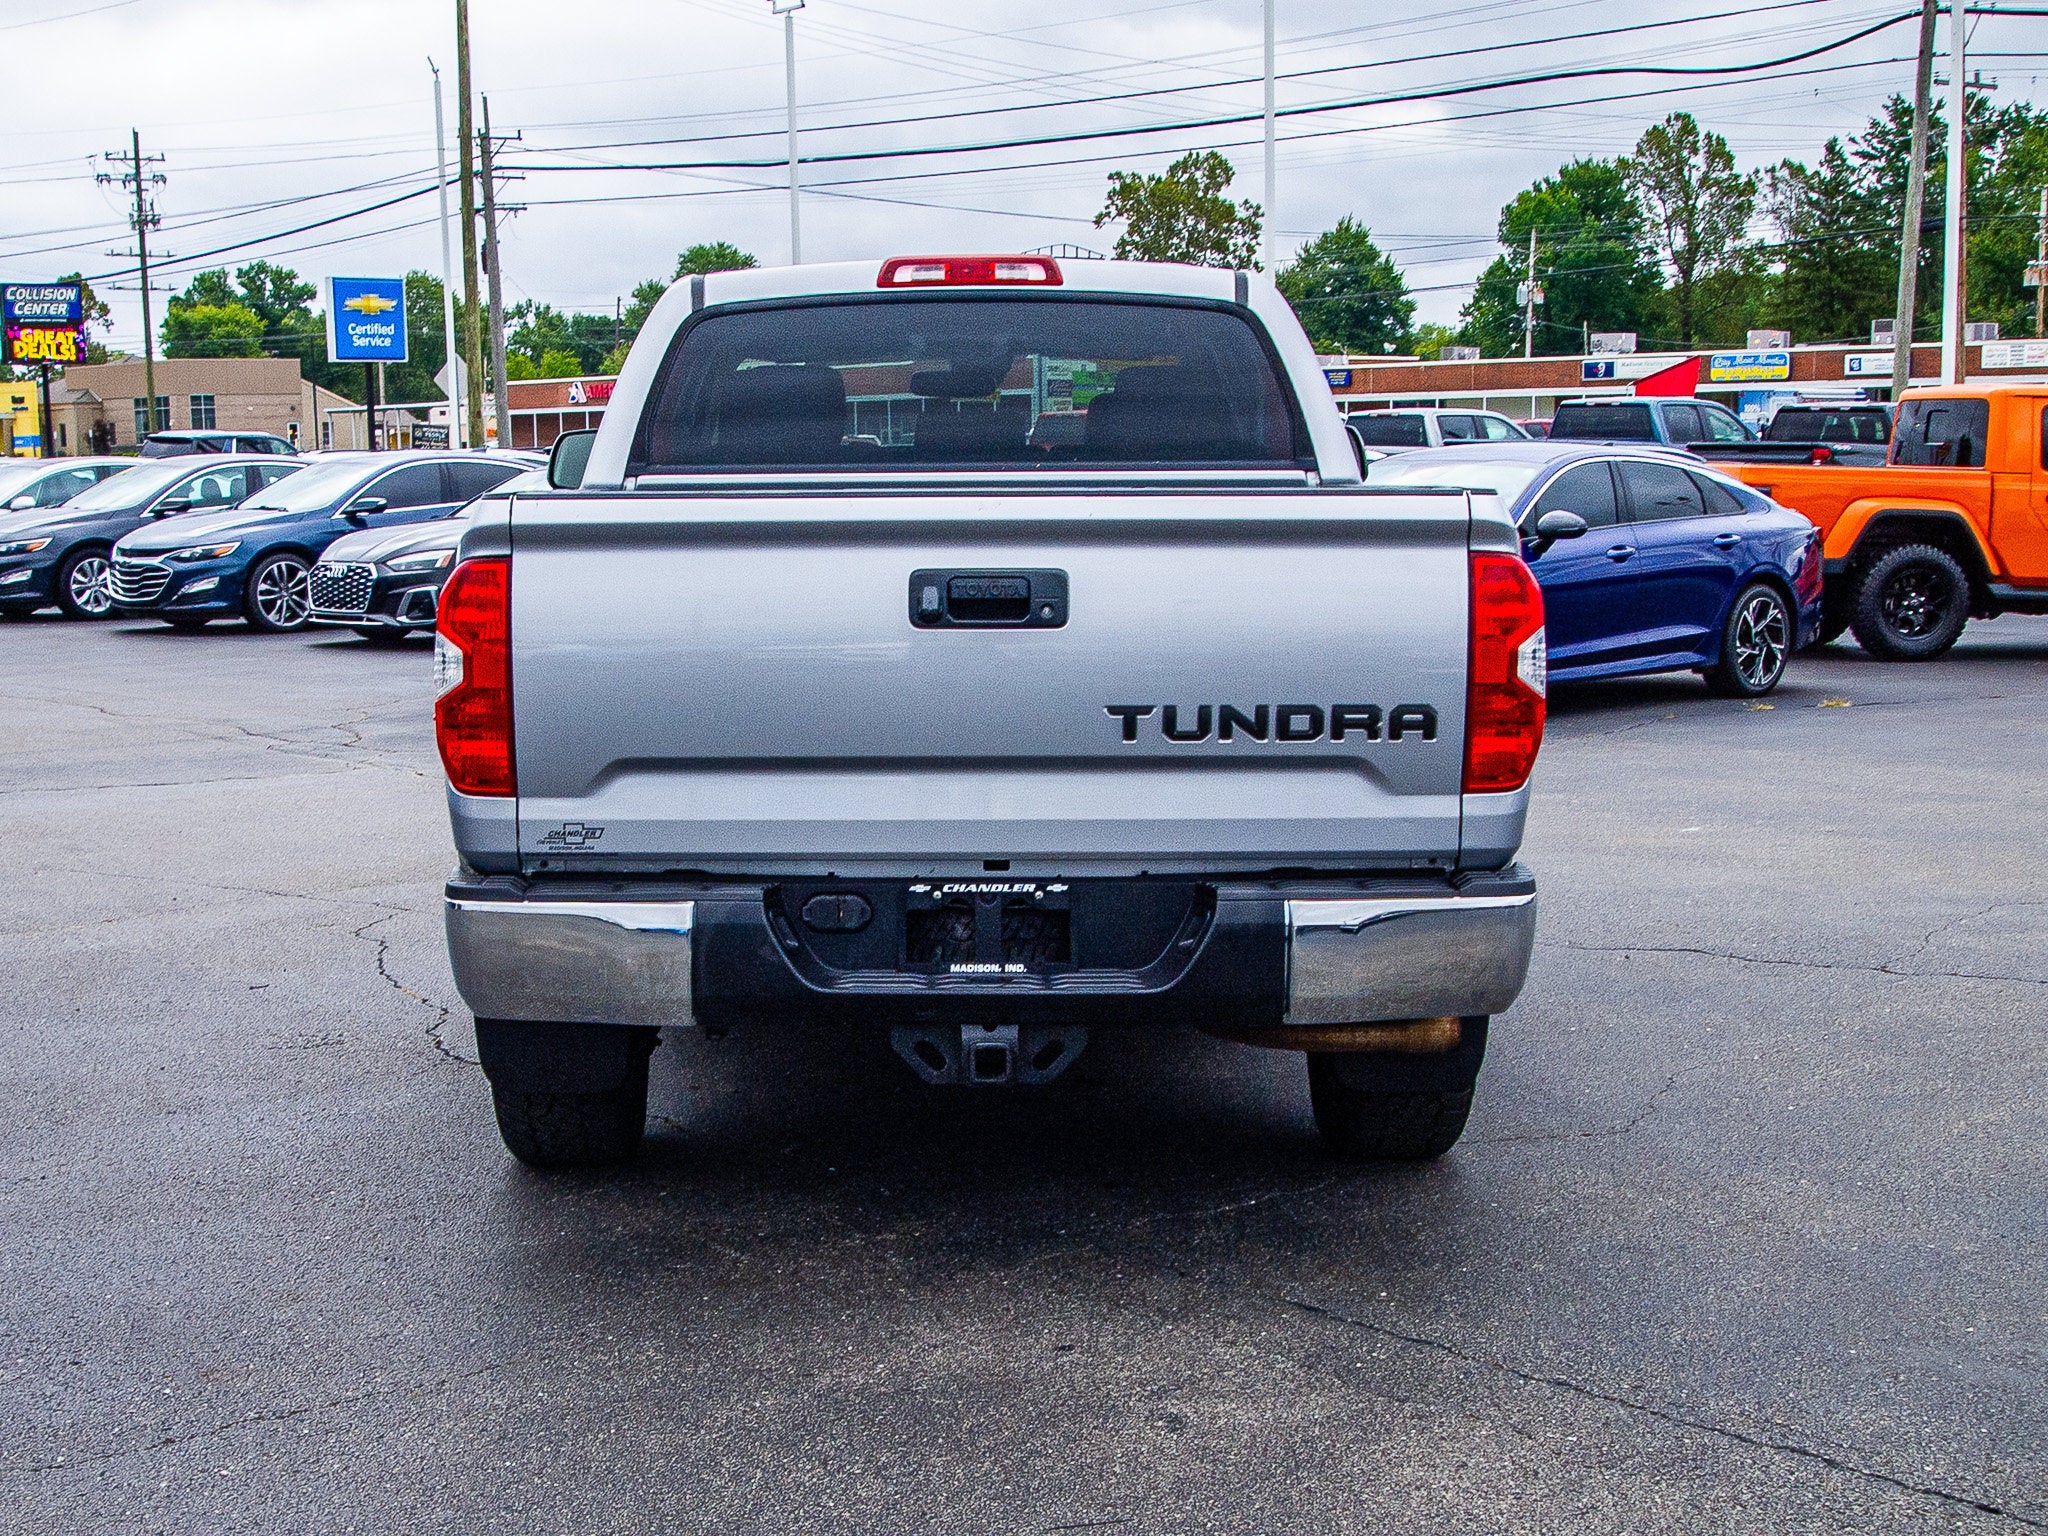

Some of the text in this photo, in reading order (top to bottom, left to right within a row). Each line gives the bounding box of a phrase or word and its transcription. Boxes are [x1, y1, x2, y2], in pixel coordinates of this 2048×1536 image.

[6, 286, 77, 300] COLLISION
[14, 302, 68, 315] CENTER
[348, 323, 395, 335] Certified
[20, 328, 76, 345] GREAT
[352, 335, 392, 347] Service
[13, 340, 77, 361] DEALS!
[955, 584, 1025, 597] TOYOTA
[1103, 704, 1439, 744] TUNDRA
[547, 830, 598, 838] CHANDLER
[942, 883, 1036, 893] CHANDLER
